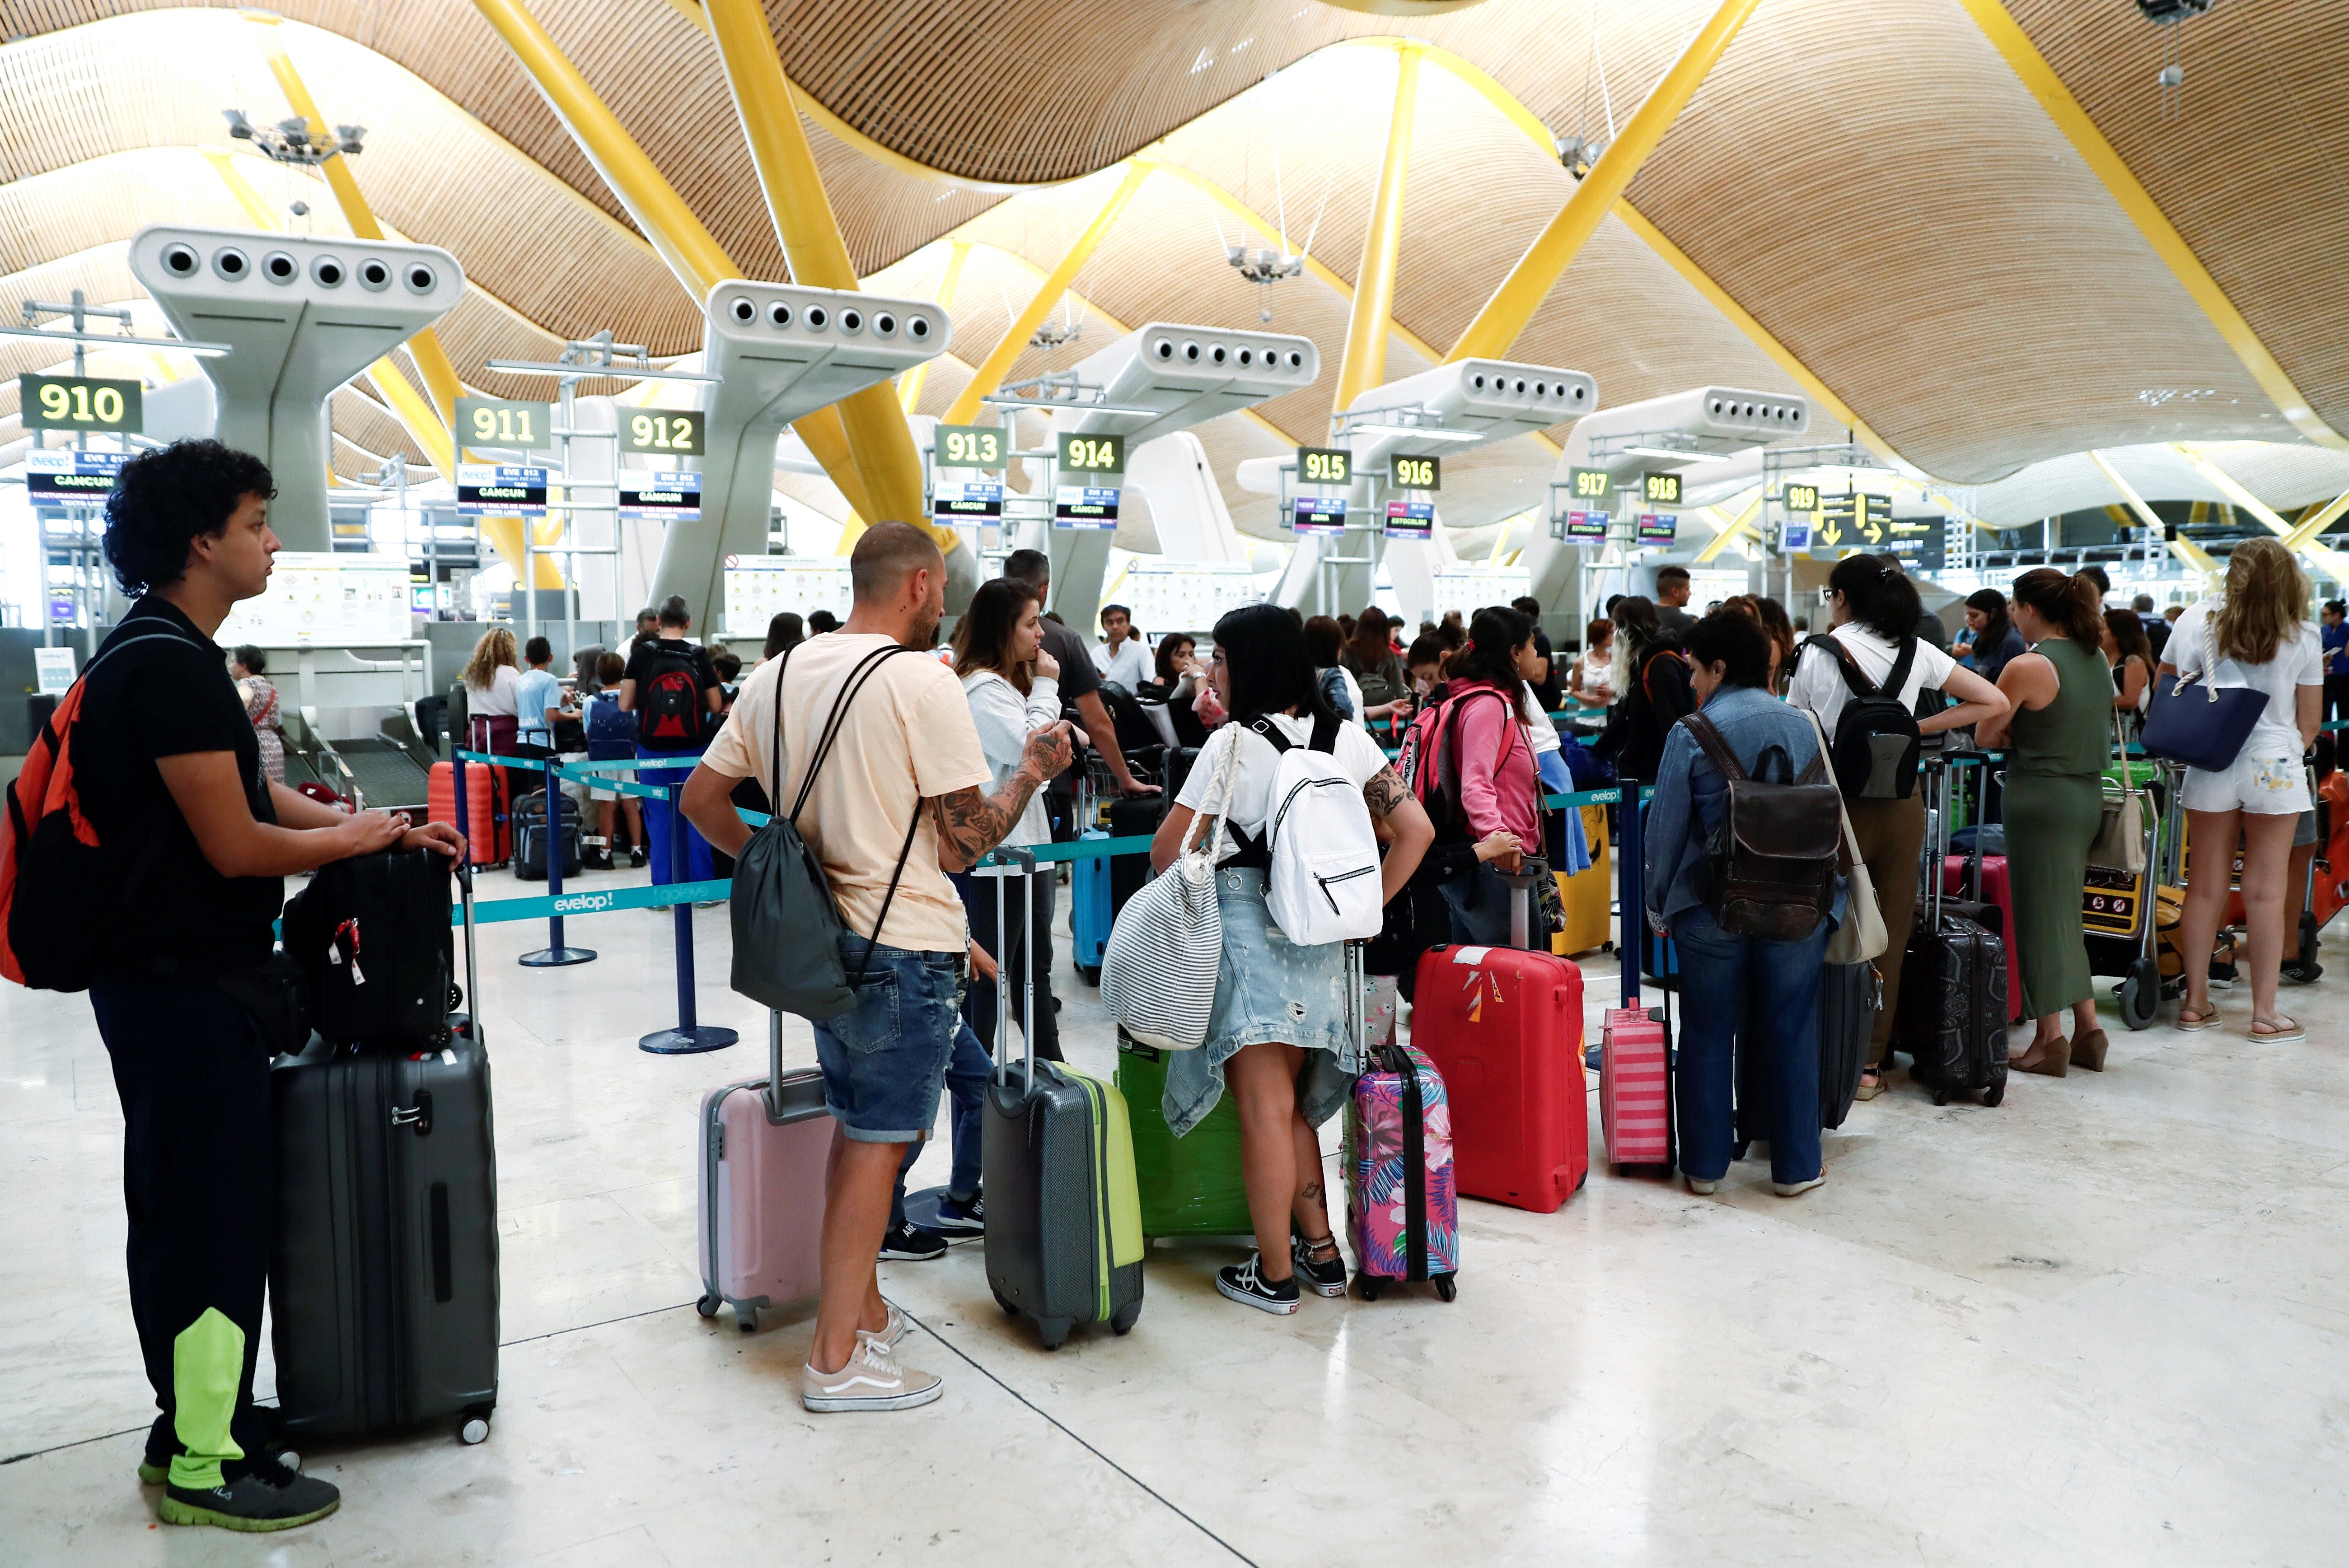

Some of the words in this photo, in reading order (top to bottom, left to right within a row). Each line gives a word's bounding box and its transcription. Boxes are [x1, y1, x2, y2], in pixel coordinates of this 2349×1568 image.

[40, 384, 123, 422] 910
[473, 407, 534, 442] 911
[632, 415, 692, 448] 912
[947, 433, 997, 462] 913
[1069, 440, 1114, 467] 914
[32, 455, 69, 468] evelop!
[84, 453, 106, 462] EVE
[503, 468, 519, 476] EVE
[1306, 453, 1345, 480] 915
[1398, 460, 1433, 485] 916
[54, 475, 115, 487] CANCUN
[462, 470, 491, 481] evelop!
[679, 474, 694, 482] 813
[1578, 472, 1607, 495] 917
[1648, 477, 1677, 499] 918
[479, 487, 526, 498] CANCUN
[638, 491, 683, 503] CANCUN
[1790, 487, 1815, 508] 919
[950, 501, 987, 511] CANCUN
[1070, 505, 1104, 514] CANCUN
[639, 759, 667, 768] evelop!
[1591, 789, 1620, 802] evelop!
[554, 892, 613, 912] evelop!
[902, 1223, 917, 1238] ARE
[213, 1486, 232, 1500] ILA
